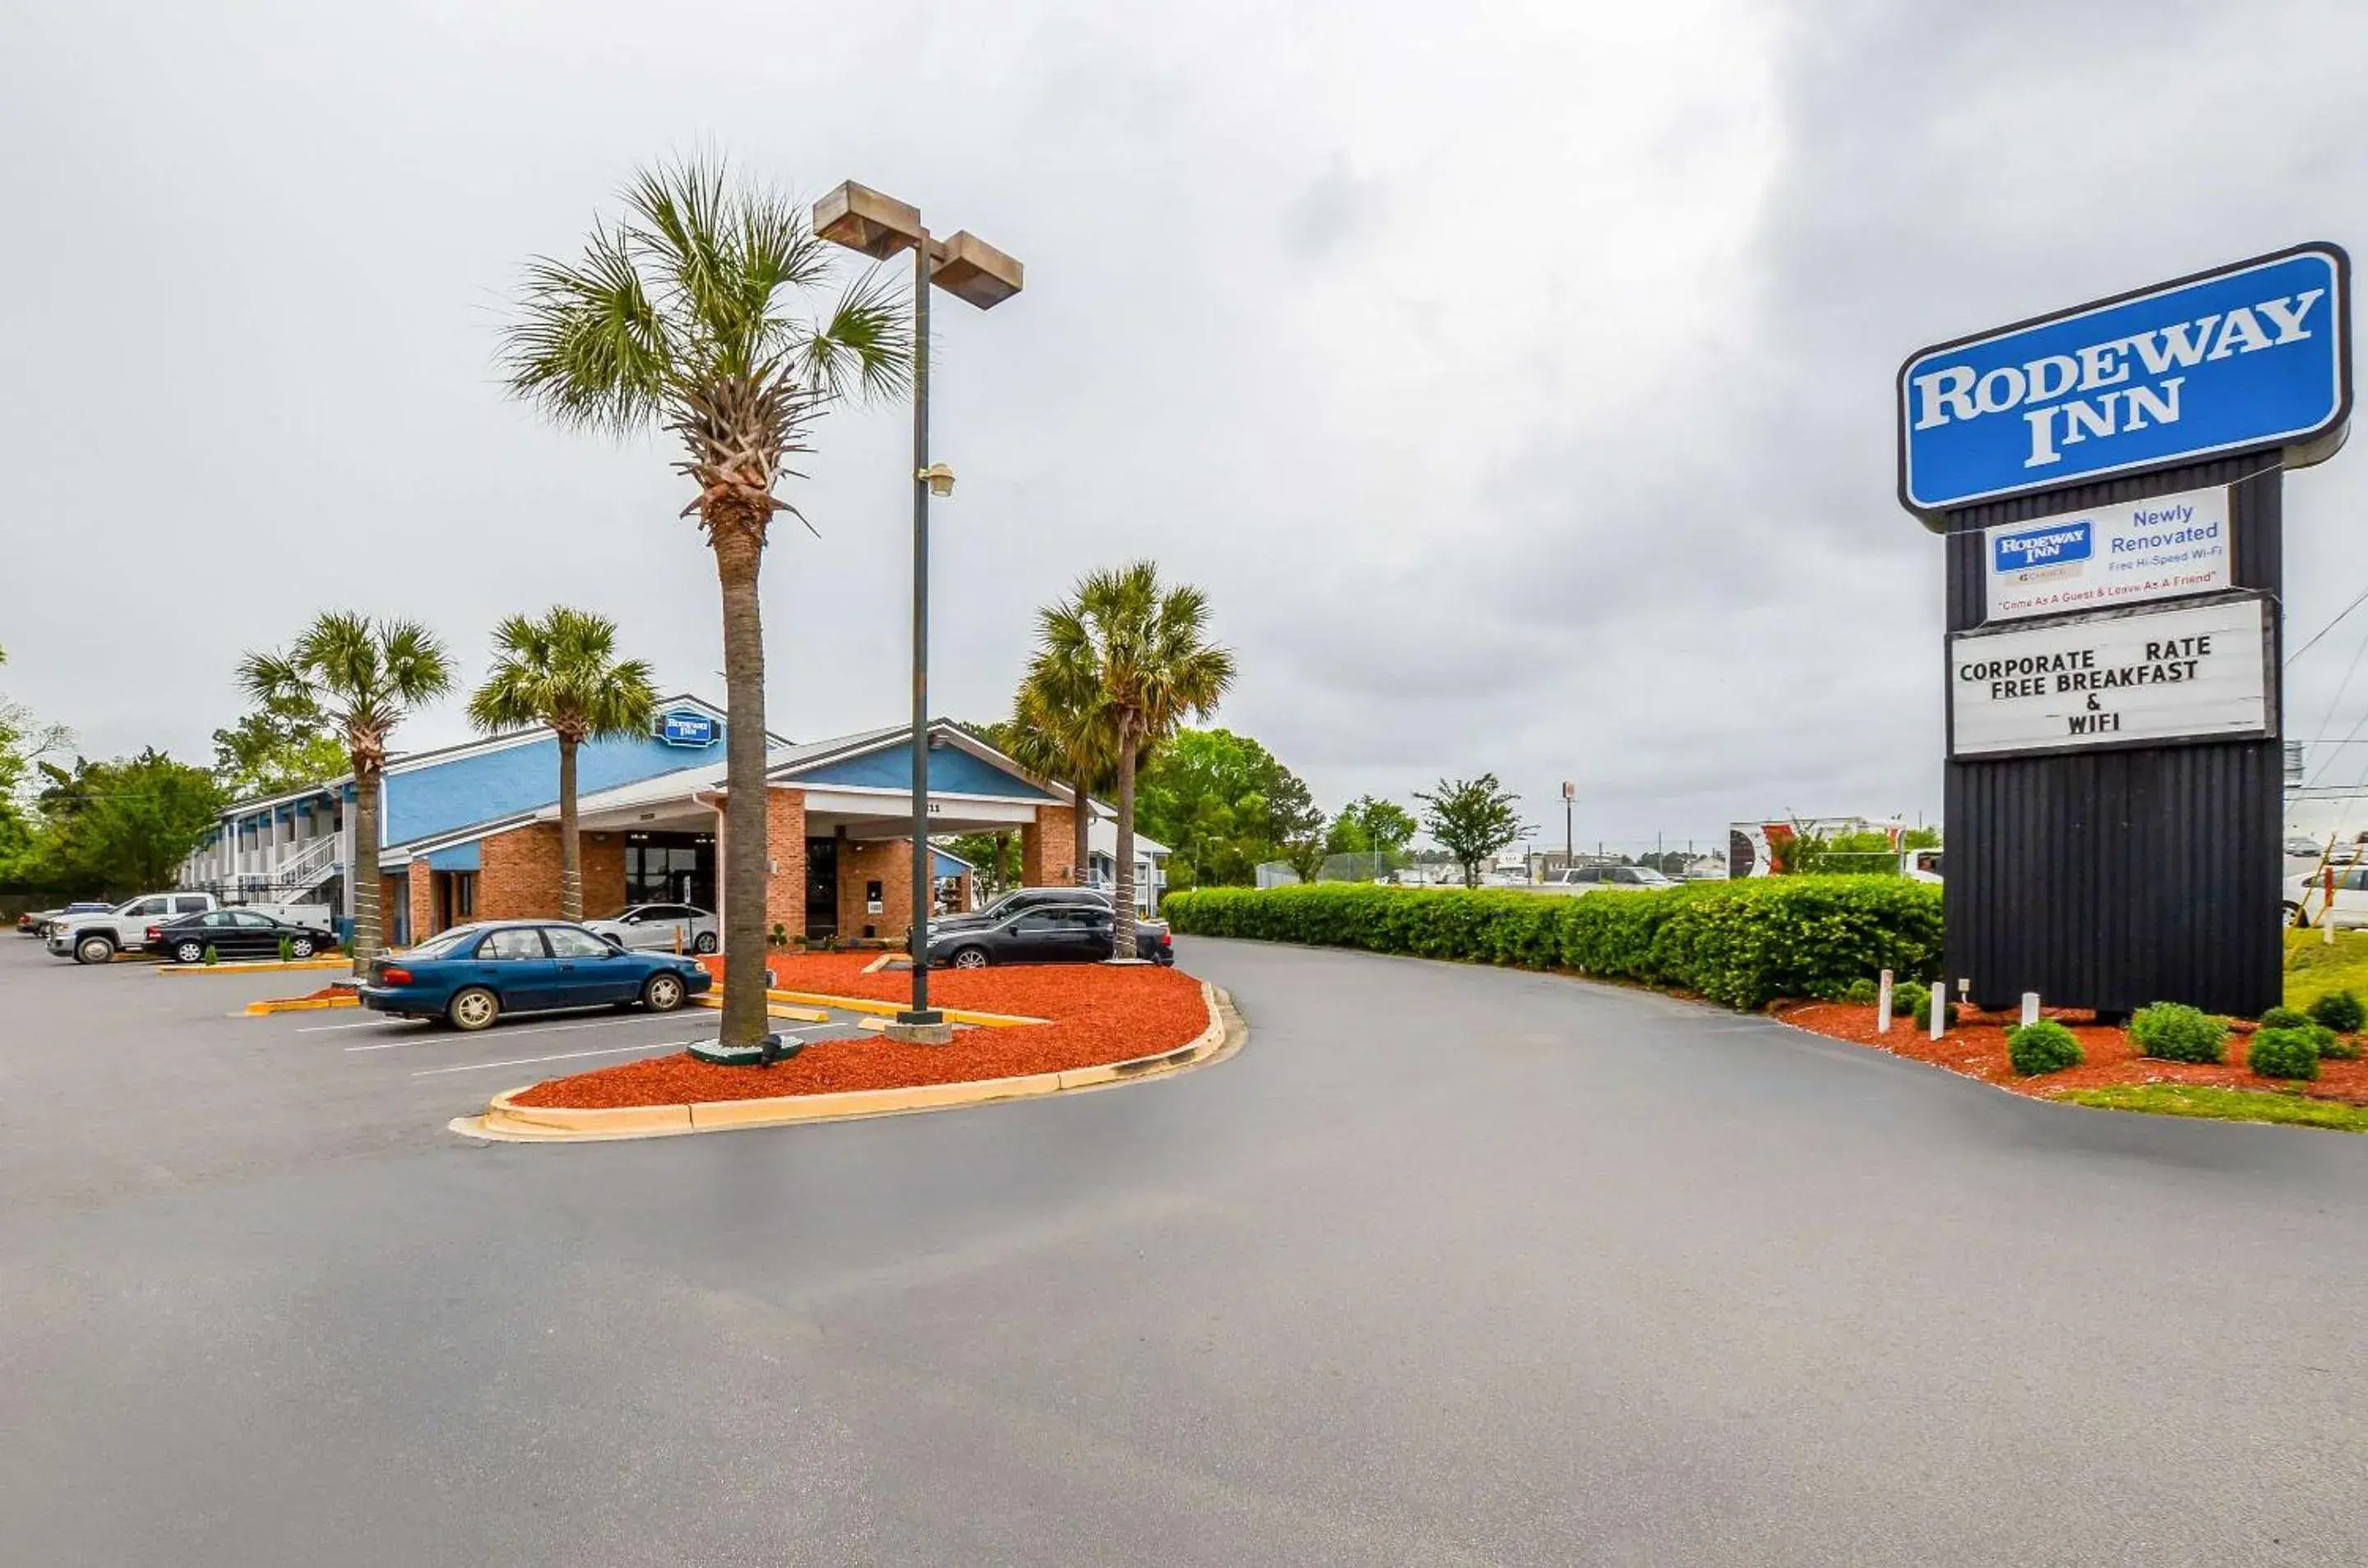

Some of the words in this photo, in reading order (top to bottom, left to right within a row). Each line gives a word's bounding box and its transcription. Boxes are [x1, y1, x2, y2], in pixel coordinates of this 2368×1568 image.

[1913, 288, 2325, 430] RODEWAY
[2023, 377, 2185, 469] INN
[2133, 505, 2195, 528] Newly
[2000, 529, 2085, 554] RODEWAY
[2111, 522, 2218, 553] Renovated
[2026, 543, 2060, 563] INN
[2108, 562, 2133, 571] Free
[2191, 545, 2222, 560] Wi-Fi
[2051, 594, 2059, 604] A
[2062, 590, 2093, 603] Guest
[2162, 578, 2170, 587] A
[1959, 650, 2095, 682] CORPORATE
[2146, 636, 2212, 661] RATE
[1991, 677, 2047, 700] FREE
[2056, 660, 2199, 693] BREAKFAST
[2087, 693, 2101, 711] &
[2068, 712, 2121, 735] WIFI
